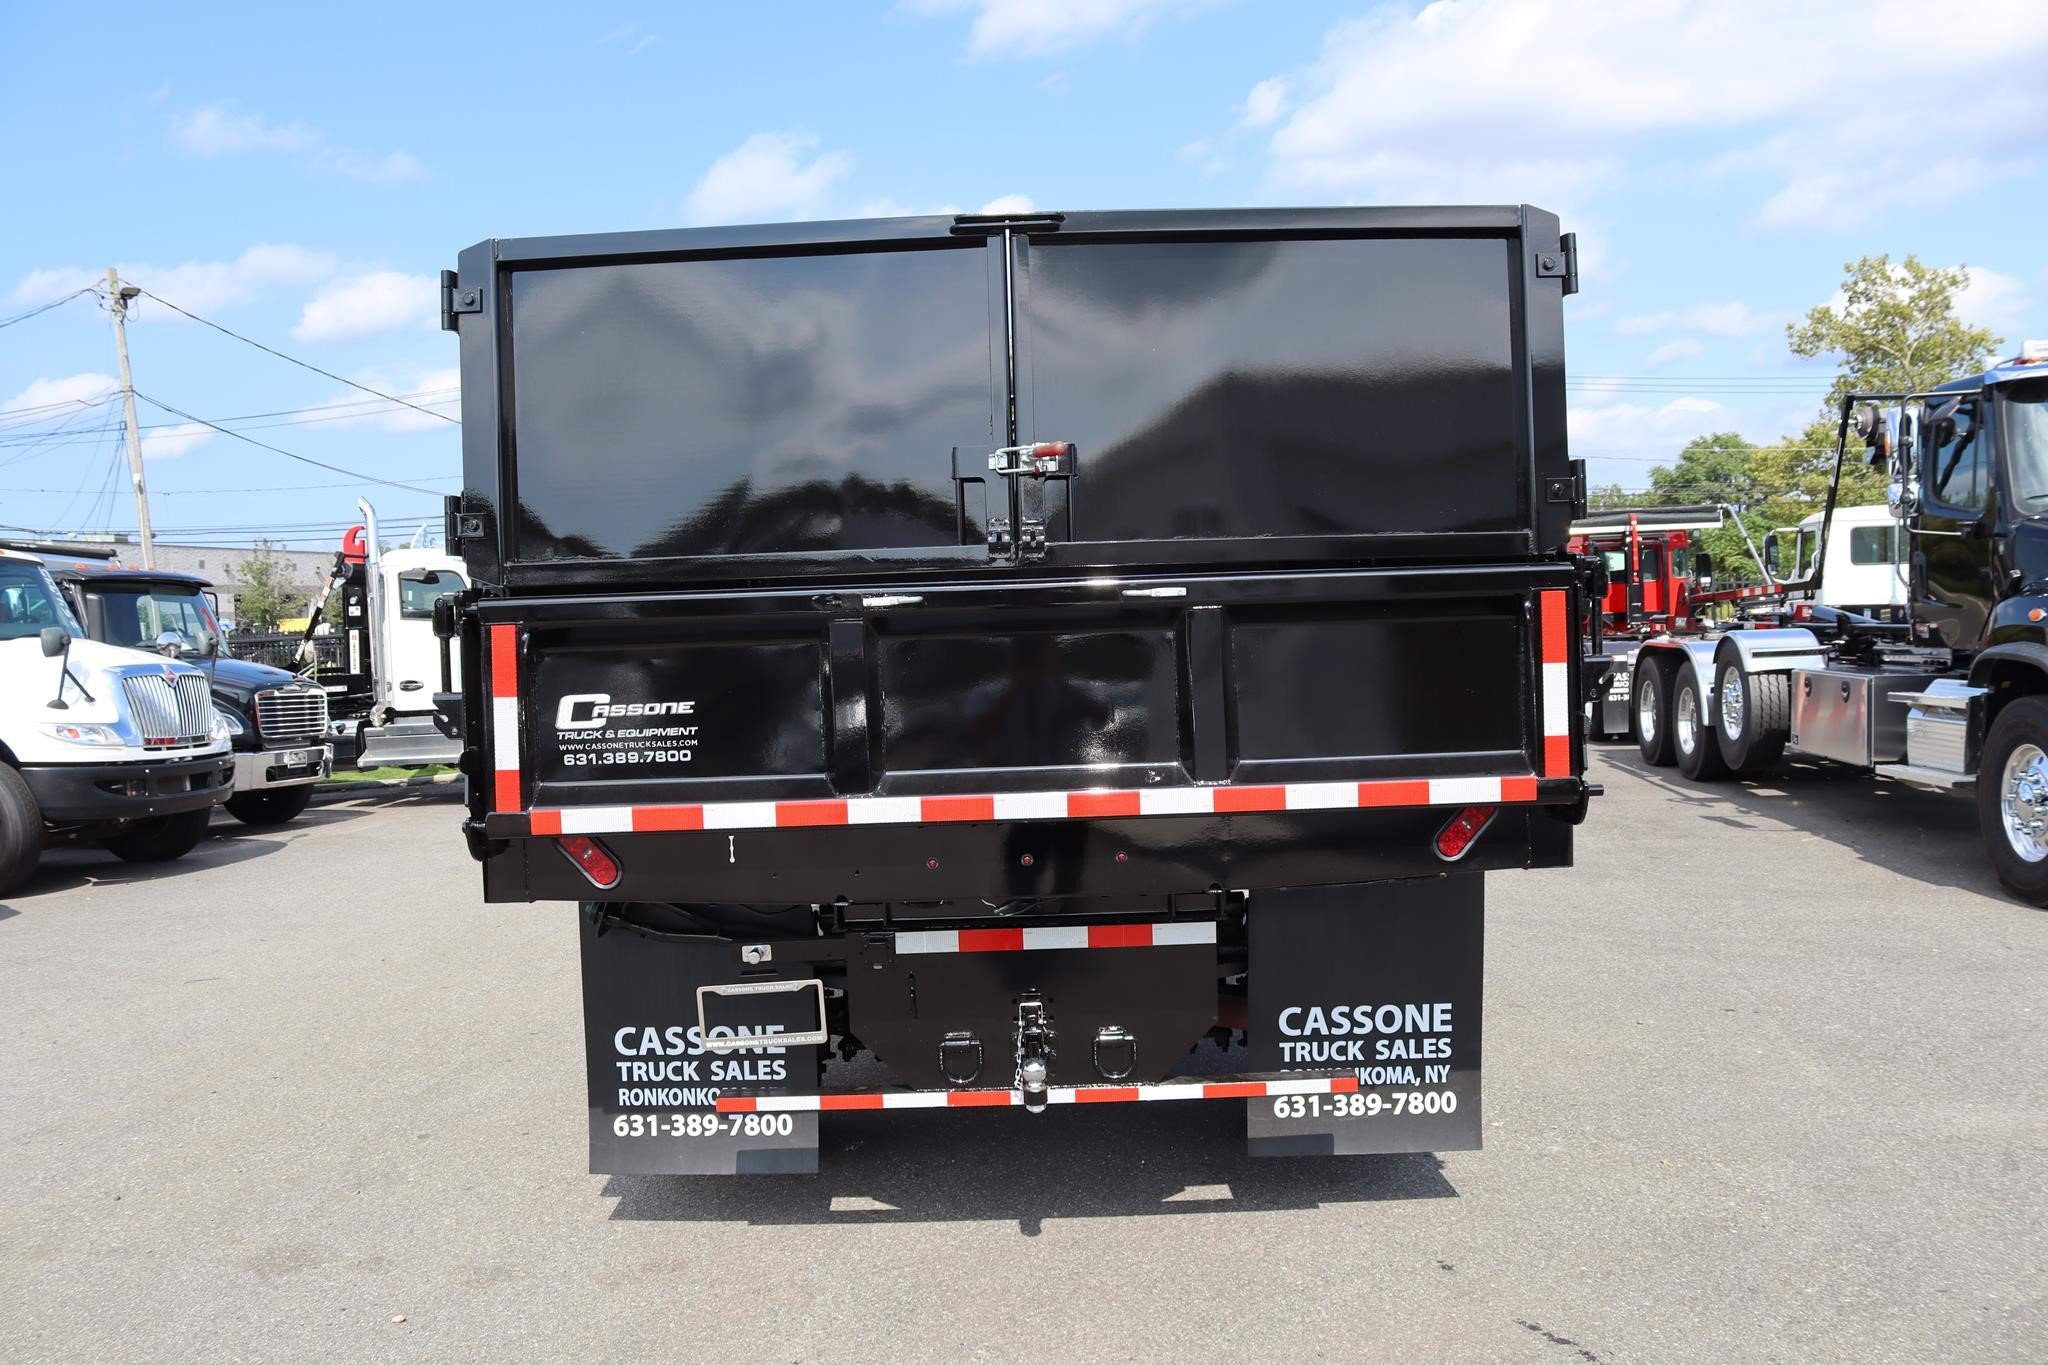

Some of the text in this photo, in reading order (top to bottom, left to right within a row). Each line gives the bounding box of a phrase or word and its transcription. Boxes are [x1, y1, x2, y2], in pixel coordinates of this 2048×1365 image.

[556, 727, 698, 740] TRUCK & EQUIPMENT
[558, 739, 698, 751] WWWCASSONETRUCKSALES.COM
[563, 750, 691, 765] 631.389.7800
[1279, 1003, 1453, 1037] CASSONE
[614, 1024, 787, 1056] CASSONE
[1279, 1038, 1452, 1062] TRUCK SALES
[616, 1060, 787, 1082] TRUCK SALES
[1425, 1064, 1451, 1083] NY
[618, 1088, 722, 1106] RONKONKO
[1274, 1091, 1457, 1118] 631-389-7800
[613, 1113, 793, 1137] 631-389-7800
